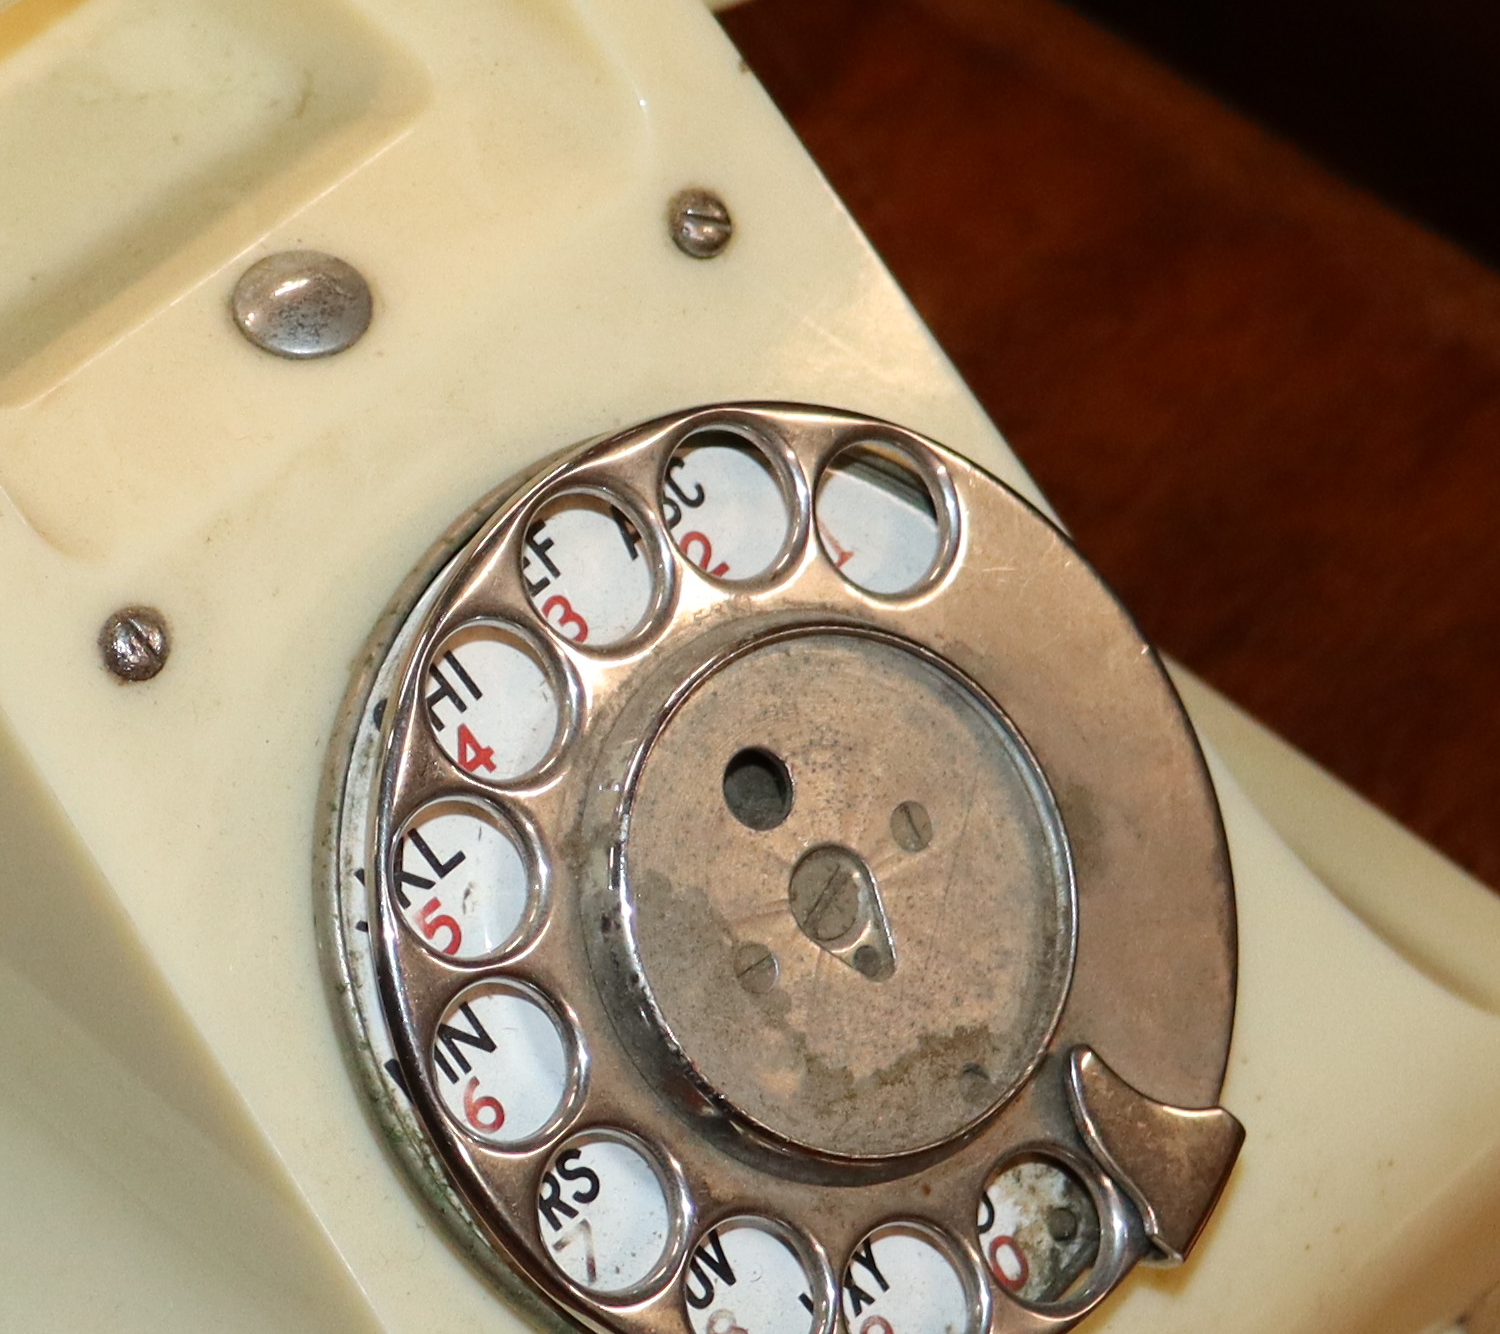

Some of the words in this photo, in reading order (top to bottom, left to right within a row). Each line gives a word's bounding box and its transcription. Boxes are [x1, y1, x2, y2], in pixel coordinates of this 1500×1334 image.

[678, 530, 731, 578] 2
[540, 594, 590, 645] 3
[424, 649, 484, 733] HI
[456, 722, 498, 773] 4
[417, 896, 463, 956] 5
[463, 1075, 506, 1135] 6
[538, 1147, 601, 1233] RS
[552, 1218, 598, 1285] 7
[684, 1227, 738, 1311] UV
[843, 1237, 891, 1319] XY
[988, 1234, 1030, 1292] 0
